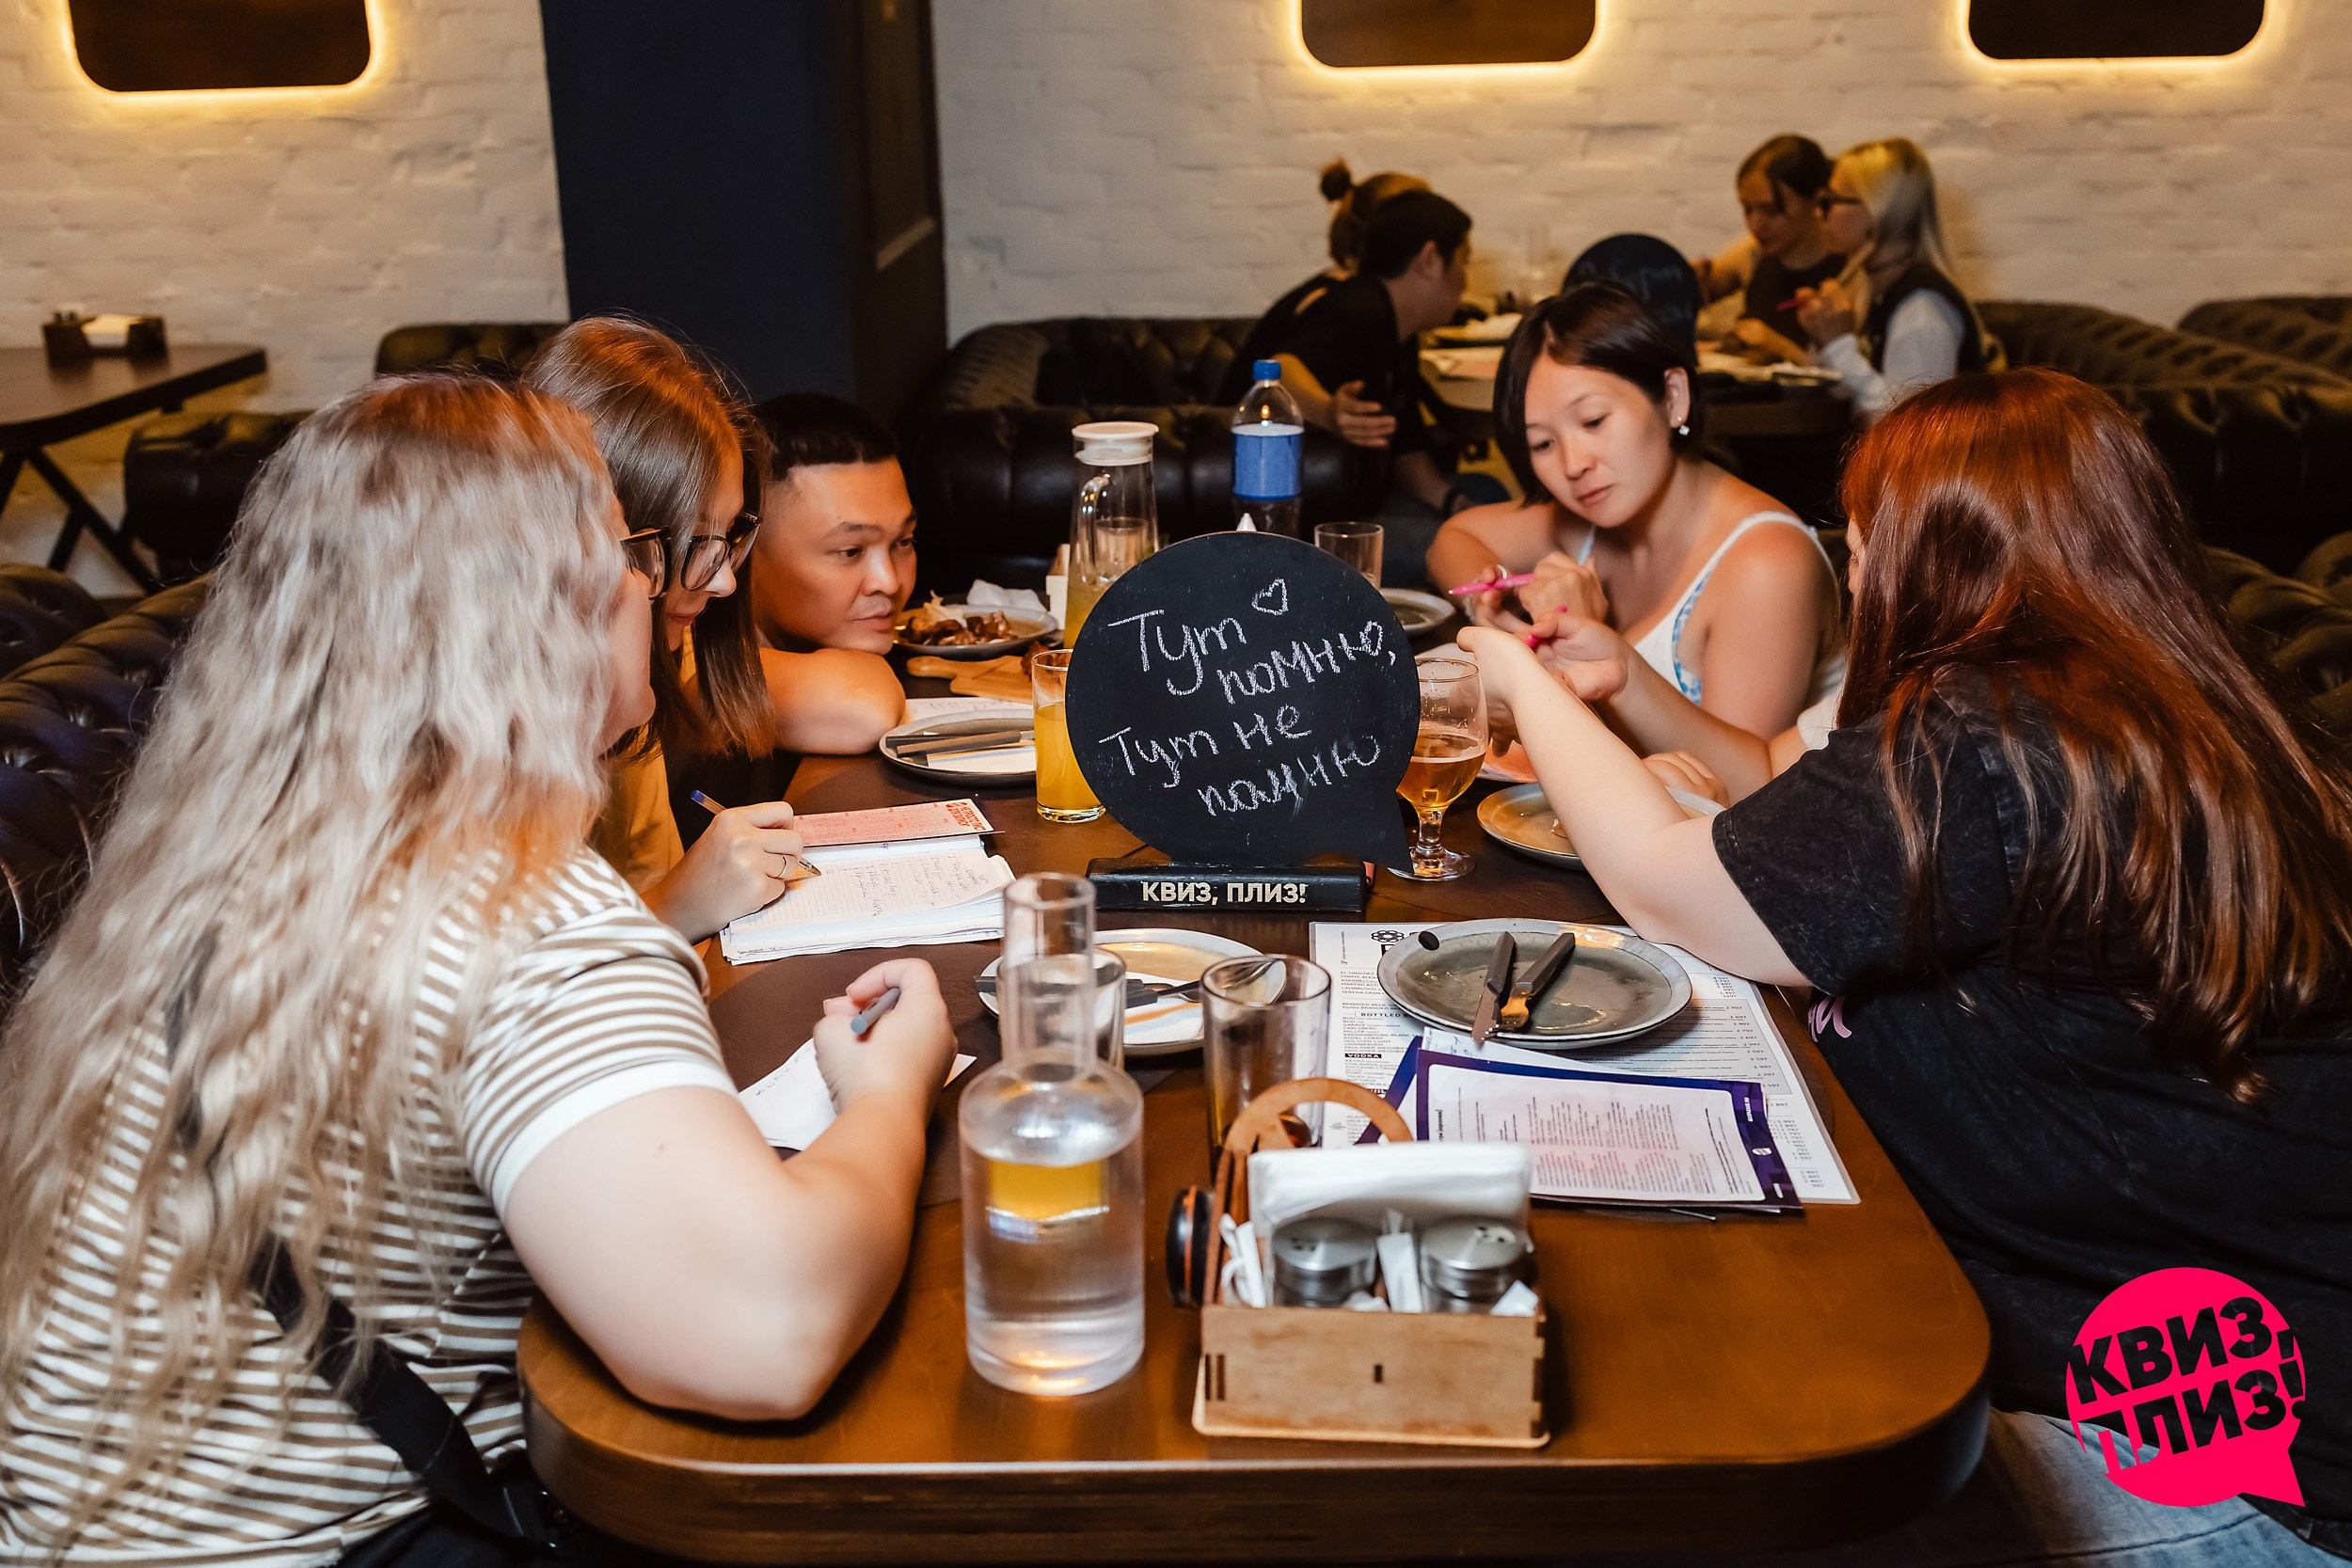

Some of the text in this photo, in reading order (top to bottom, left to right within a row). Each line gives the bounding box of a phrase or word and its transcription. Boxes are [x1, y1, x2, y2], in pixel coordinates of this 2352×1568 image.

[1108, 610, 1248, 696] Тут
[1099, 704, 1312, 788] Тут не
[1141, 881, 1308, 906] КВИЗ, ПЛИЗ!
